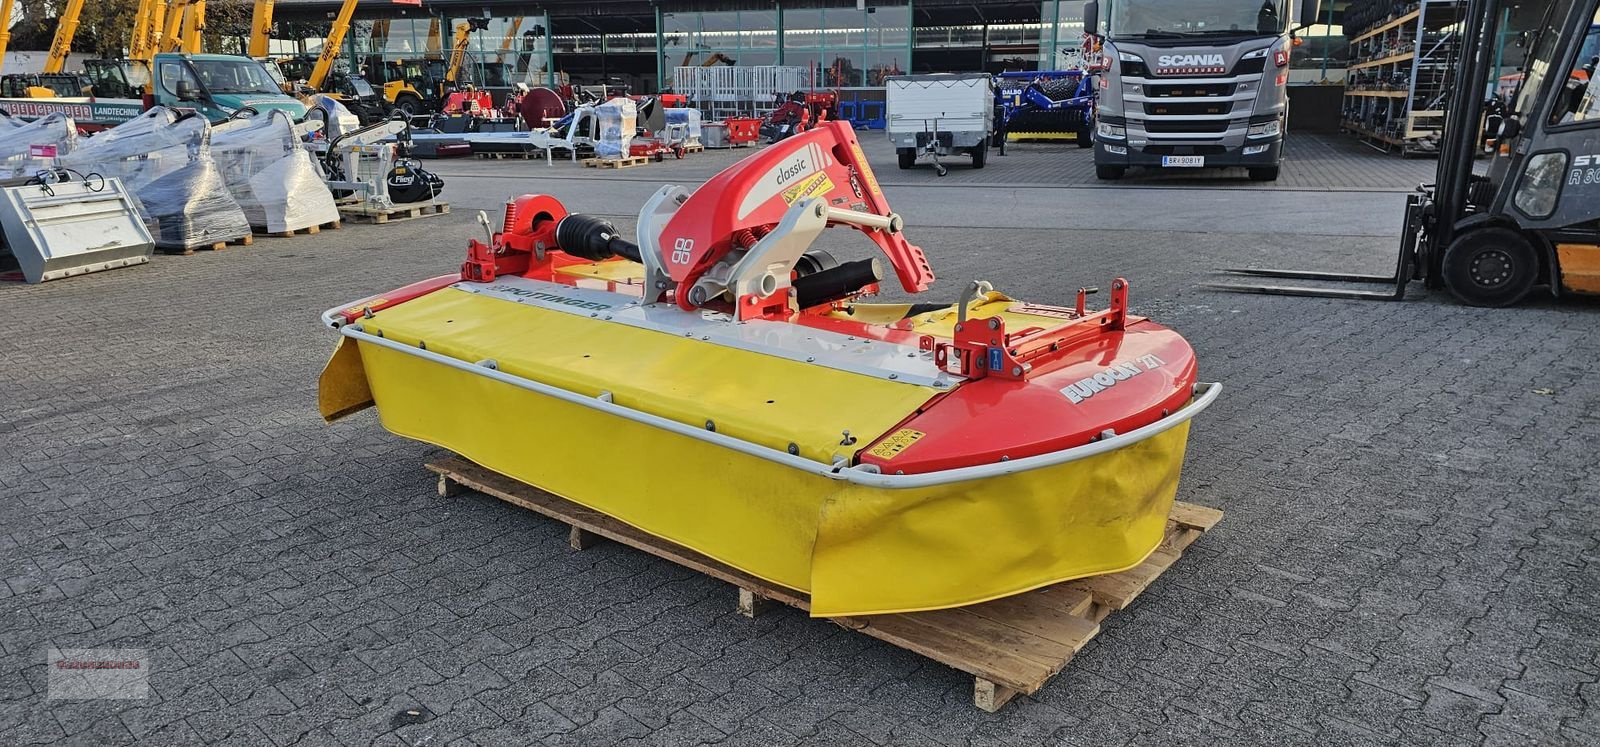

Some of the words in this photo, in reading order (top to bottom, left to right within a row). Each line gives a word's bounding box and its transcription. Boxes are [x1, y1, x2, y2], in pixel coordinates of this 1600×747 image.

[1158, 54, 1225, 66] SCANIA
[94, 106, 140, 117] LANDTECHNIK
[776, 159, 807, 185] classic
[1059, 361, 1143, 405] EUROCAT
